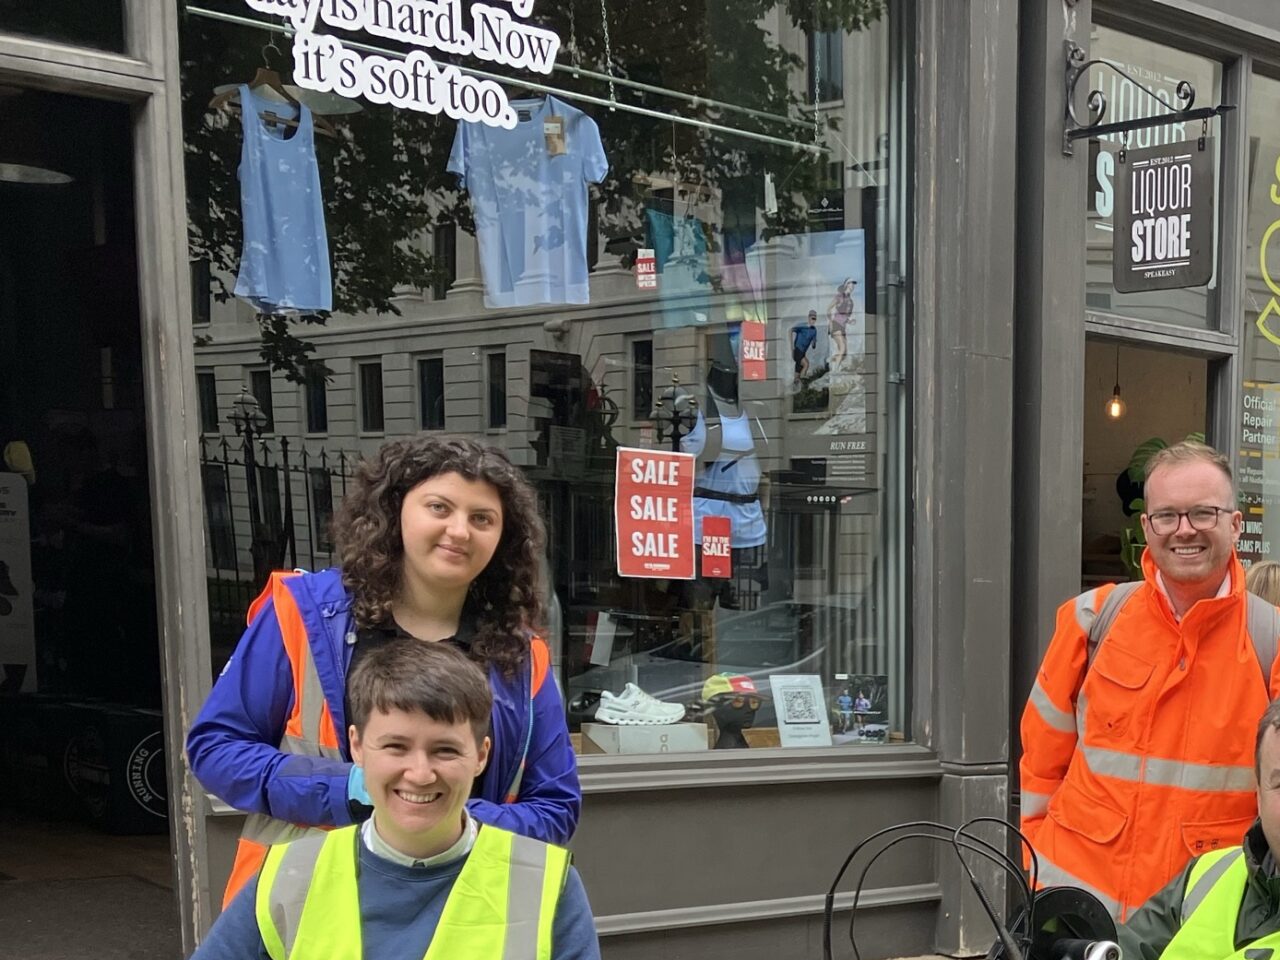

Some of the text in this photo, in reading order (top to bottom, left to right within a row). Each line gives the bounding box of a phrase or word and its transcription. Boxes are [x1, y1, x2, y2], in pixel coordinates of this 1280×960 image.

[479, 12, 553, 66] Now
[370, 59, 436, 105] soft
[448, 71, 511, 121] too.
[1131, 164, 1191, 217] LIQUOR
[1131, 214, 1191, 263] STORE
[637, 262, 656, 273] SALE
[1144, 269, 1176, 279] SPEAKEASY
[743, 346, 765, 360] SALE
[1243, 395, 1276, 411] Official
[1243, 412, 1273, 429] Repair
[1243, 429, 1276, 444] Partner
[830, 441, 866, 450] RUN FREE
[631, 458, 680, 486] SALE
[630, 495, 678, 522] SALE
[1246, 521, 1263, 534] WING
[631, 531, 679, 558] SALE
[703, 542, 730, 557] SALE
[1255, 541, 1270, 554] PLUS
